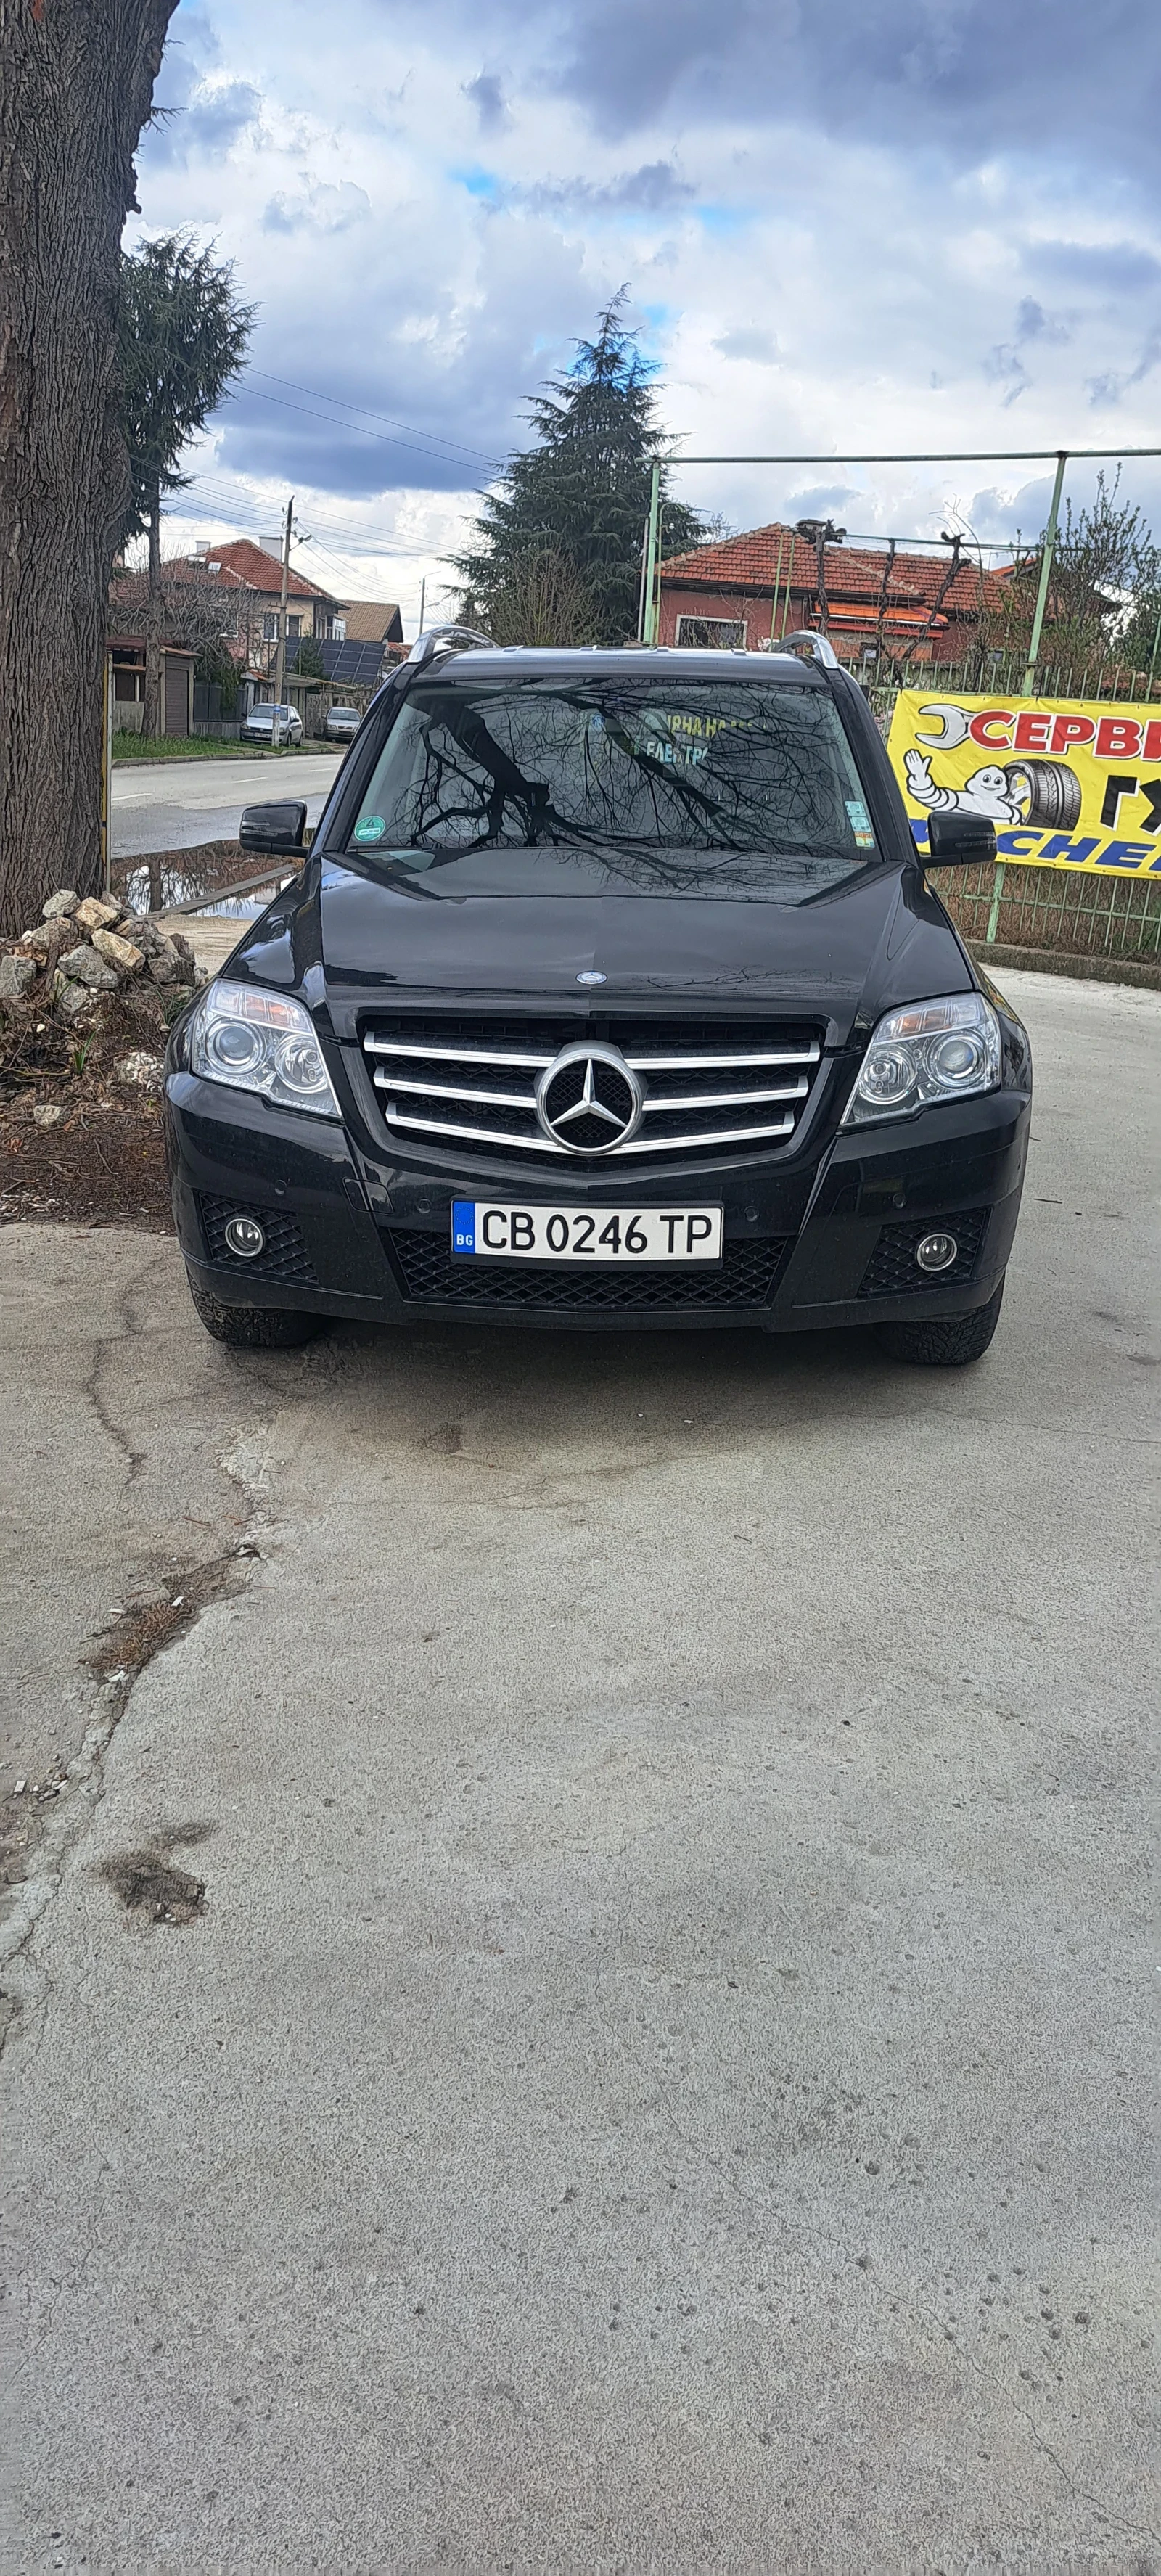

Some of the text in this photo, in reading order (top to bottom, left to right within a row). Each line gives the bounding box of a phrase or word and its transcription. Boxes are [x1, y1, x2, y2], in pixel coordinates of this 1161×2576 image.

[996, 830, 1161, 871] CHE
[456, 1234, 473, 1246] BG
[483, 1210, 712, 1254] CB 0246 TP
